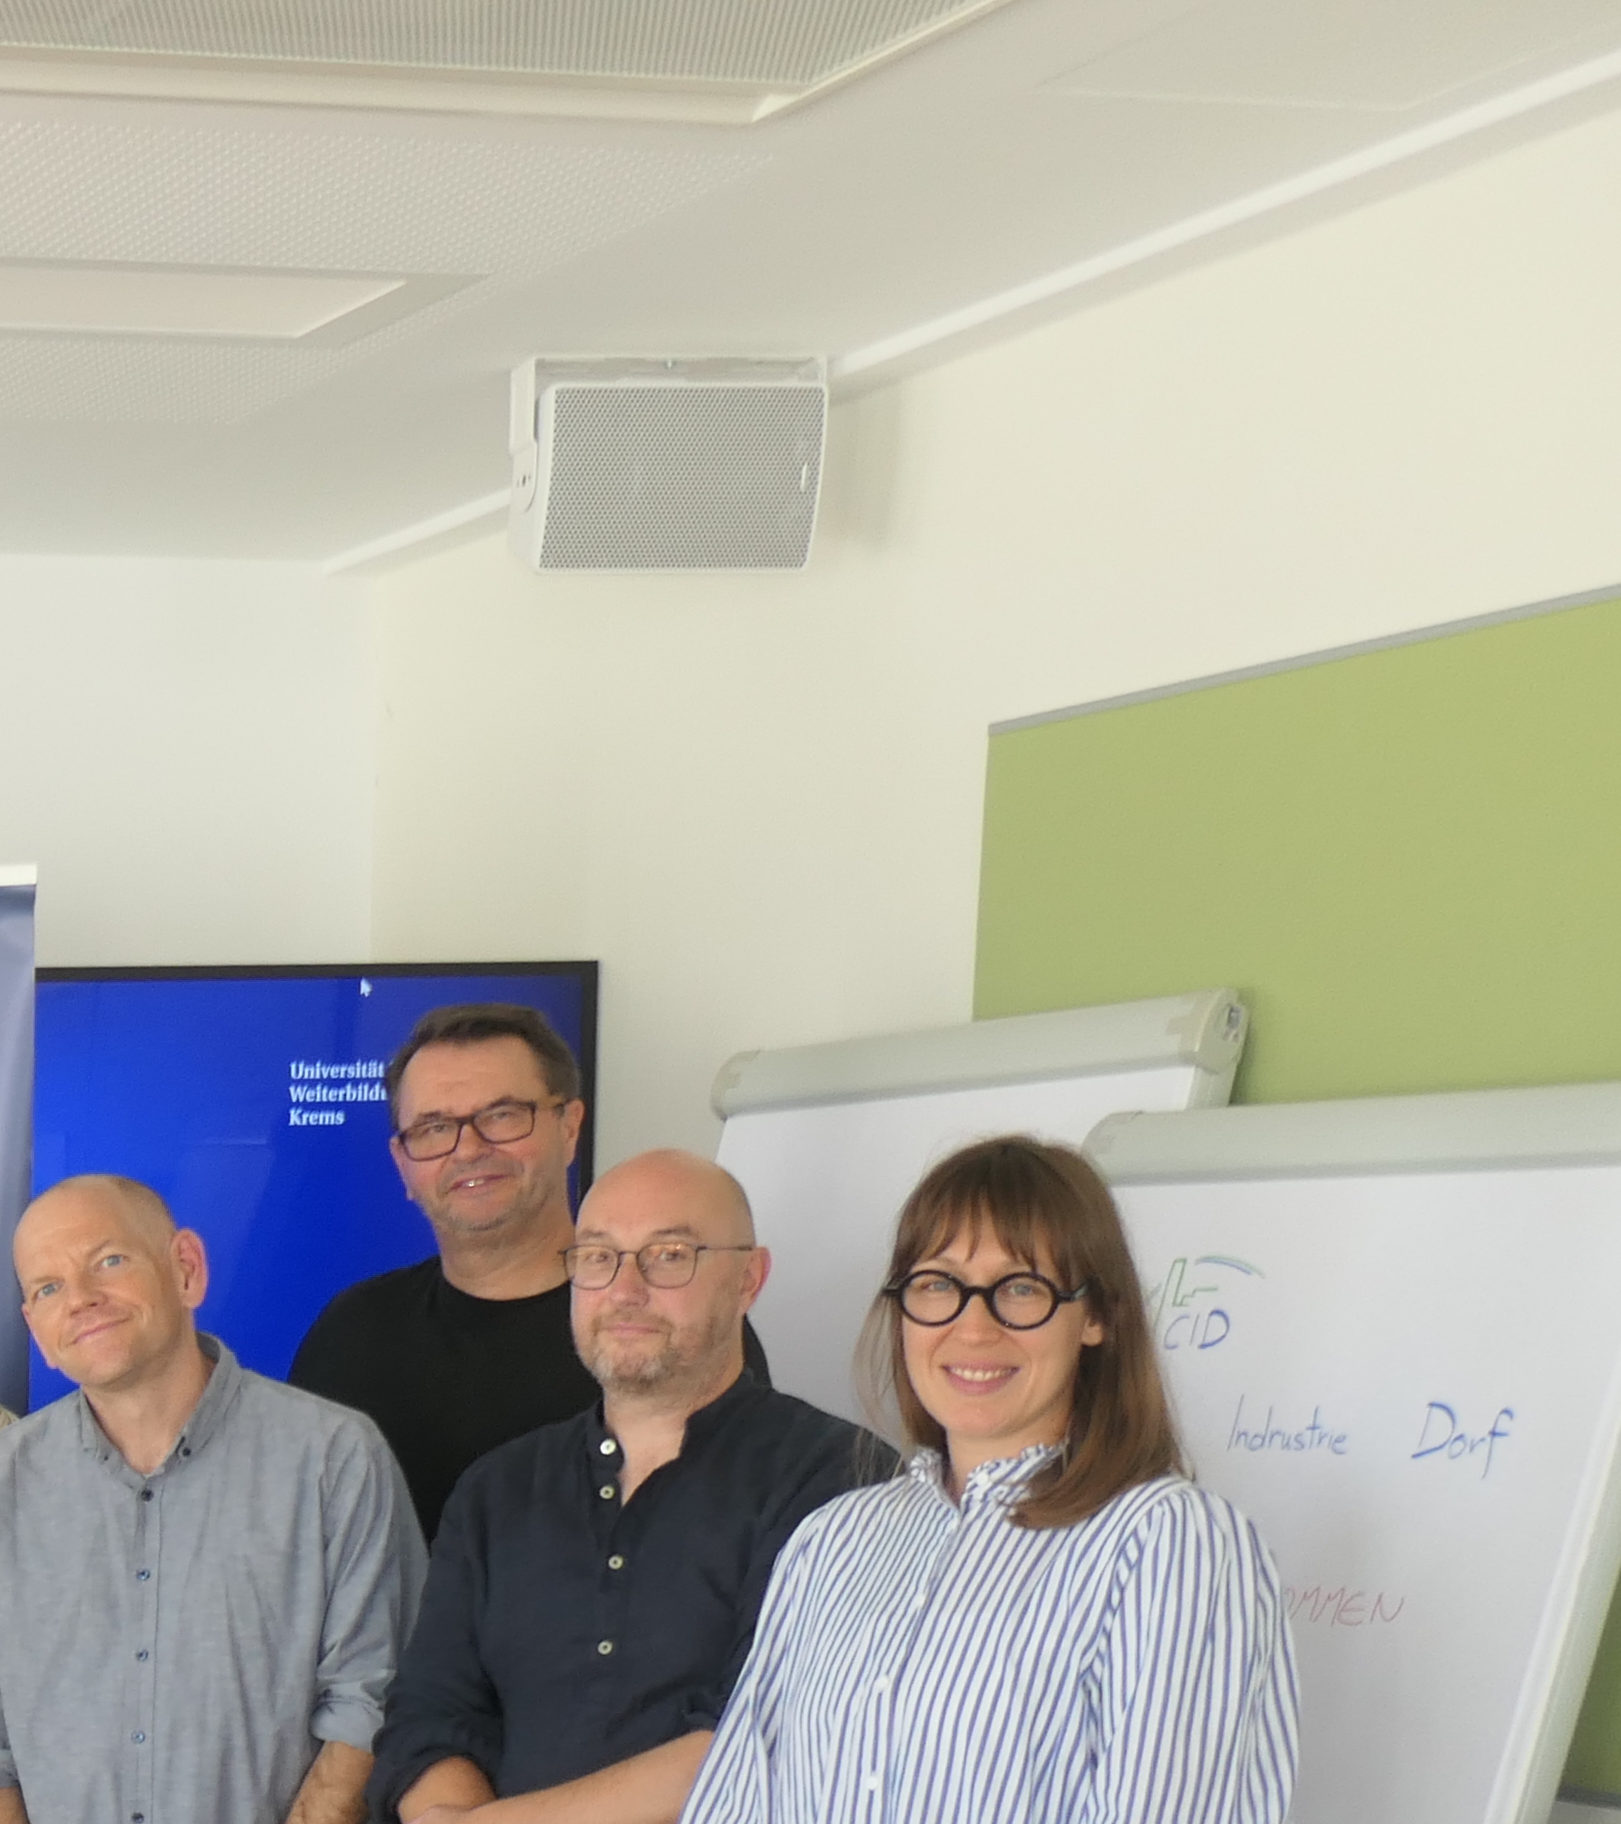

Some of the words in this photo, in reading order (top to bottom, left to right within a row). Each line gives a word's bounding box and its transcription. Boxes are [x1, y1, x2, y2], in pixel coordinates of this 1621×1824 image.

[289, 1060, 385, 1080] Universität
[288, 1082, 387, 1103] Weiterbildu
[288, 1106, 345, 1126] Krems
[1410, 1401, 1515, 1481] Dorf
